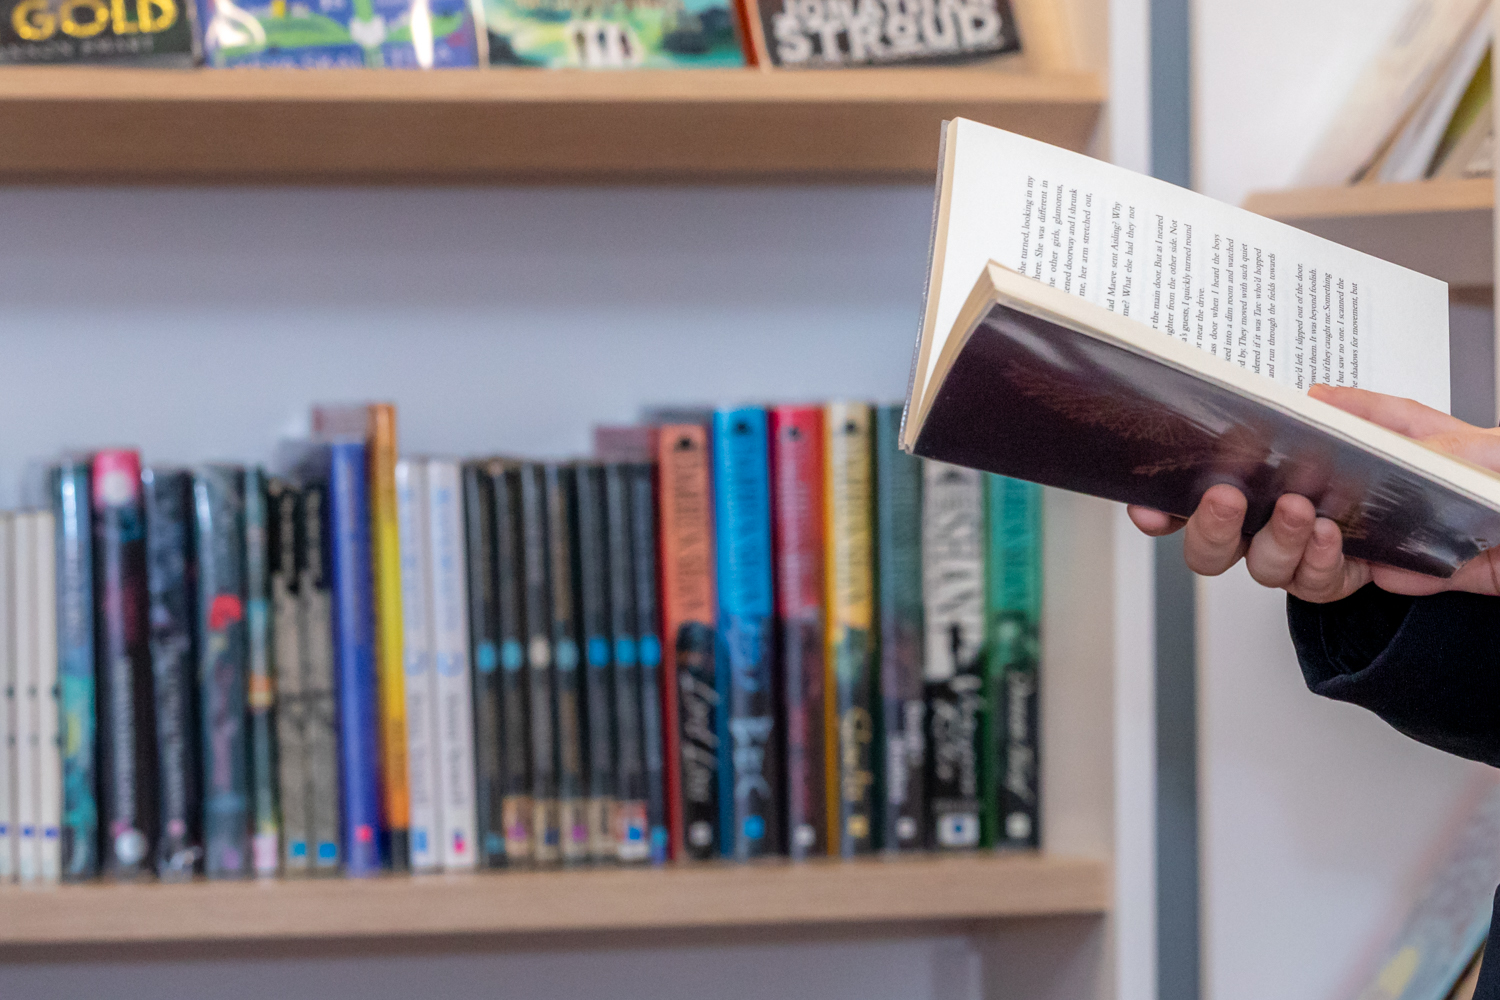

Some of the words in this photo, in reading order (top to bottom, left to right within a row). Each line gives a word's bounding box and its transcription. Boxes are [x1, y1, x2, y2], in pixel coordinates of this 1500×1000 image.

[773, 12, 1002, 64] STROUD
[1038, 191, 1047, 223] different
[1052, 185, 1063, 225] glamorous,
[1068, 189, 1077, 214] shrunk
[1112, 202, 1121, 219] Why
[1021, 199, 1034, 229] looking
[1067, 220, 1075, 235] and
[1082, 210, 1091, 244] stretched
[1111, 221, 1122, 251] Aisling?
[1126, 222, 1136, 238] they
[1184, 224, 1192, 246] round
[1021, 231, 1030, 259] turned,
[1051, 229, 1061, 247] girls,
[1169, 238, 1177, 253] side.
[1212, 234, 1221, 250] boys
[1035, 243, 1043, 258] She
[1064, 237, 1076, 270] doorway
[1125, 241, 1133, 255] had
[1226, 238, 1234, 267] watched
[1242, 243, 1250, 262] quiet
[1049, 251, 1058, 272] other
[1124, 259, 1133, 273] else
[1154, 254, 1162, 268] But
[1168, 255, 1177, 275] other
[1183, 247, 1191, 272] turned
[1254, 248, 1264, 275] hopped
[1078, 266, 1087, 279] her
[1153, 270, 1161, 289] door.
[1211, 267, 1219, 288] heard
[1240, 264, 1248, 281] such
[1295, 263, 1303, 281] door.
[1309, 269, 1317, 293] foolish.
[1107, 271, 1117, 296] Maeve
[1122, 276, 1132, 296] What
[1167, 277, 1176, 289] the
[1182, 273, 1192, 301] quickly
[1295, 283, 1303, 295] the
[1323, 272, 1332, 312] Something
[1336, 278, 1344, 290] the
[1350, 282, 1358, 295] but
[1166, 292, 1175, 311] from
[1196, 288, 1204, 308] drive.
[1309, 294, 1318, 321] beyond
[1336, 290, 1344, 319] scanned
[1122, 300, 1130, 317] me?
[1150, 311, 1159, 324] the
[1195, 309, 1204, 322] the
[1211, 298, 1219, 318] when
[1225, 307, 1233, 322] dim
[1267, 303, 1275, 315] the
[1182, 307, 1190, 332] guests,
[1209, 321, 1218, 340] door
[1238, 327, 1248, 346] They
[1267, 317, 1278, 346] through
[1295, 319, 1305, 345] slipped
[1323, 325, 1333, 349] caught
[1350, 336, 1358, 348] for
[1295, 353, 1303, 366] left,
[1309, 344, 1317, 364] them.
[1323, 350, 1332, 366] they
[1266, 363, 1275, 378] and
[1350, 349, 1358, 379] shadows
[1295, 367, 1305, 389] they'd
[1336, 370, 1344, 383] but
